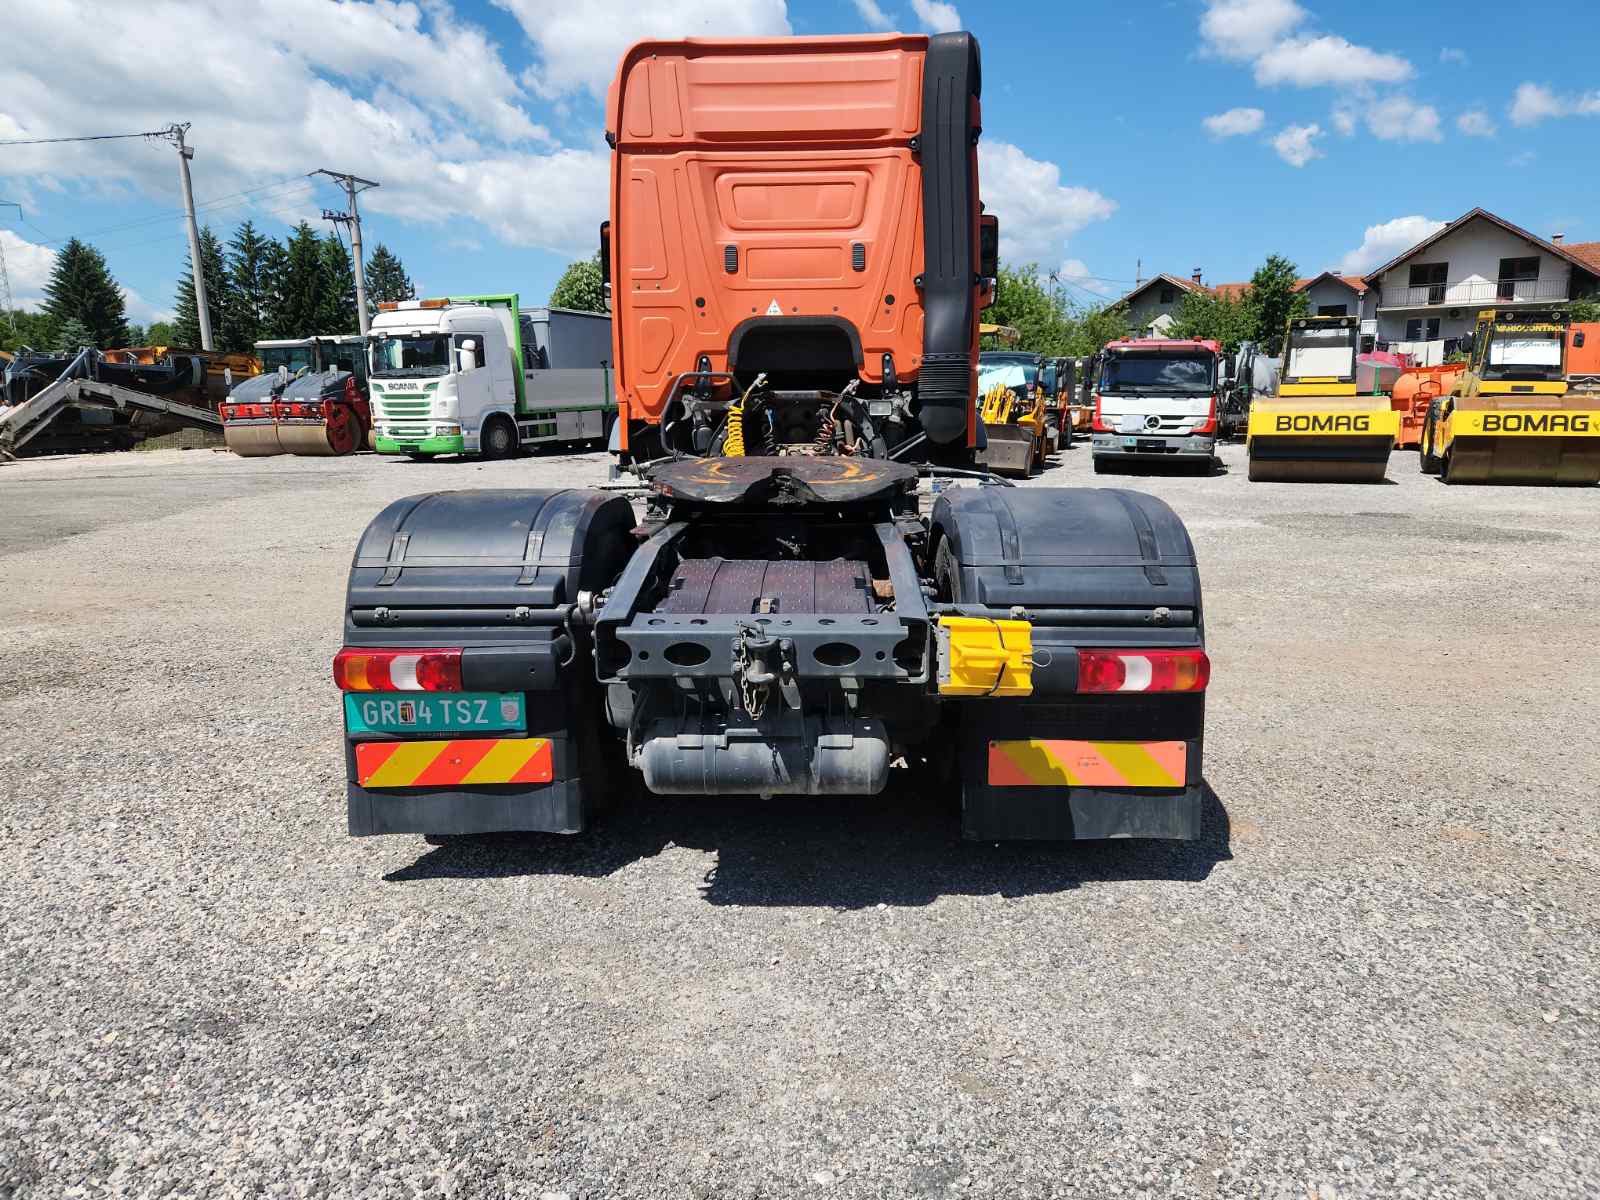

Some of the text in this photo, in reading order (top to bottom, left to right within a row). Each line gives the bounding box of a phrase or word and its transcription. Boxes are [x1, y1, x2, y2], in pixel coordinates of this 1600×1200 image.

[1276, 415, 1370, 432] BOMAG
[1482, 415, 1590, 432] BOMAG
[362, 700, 397, 725] GR
